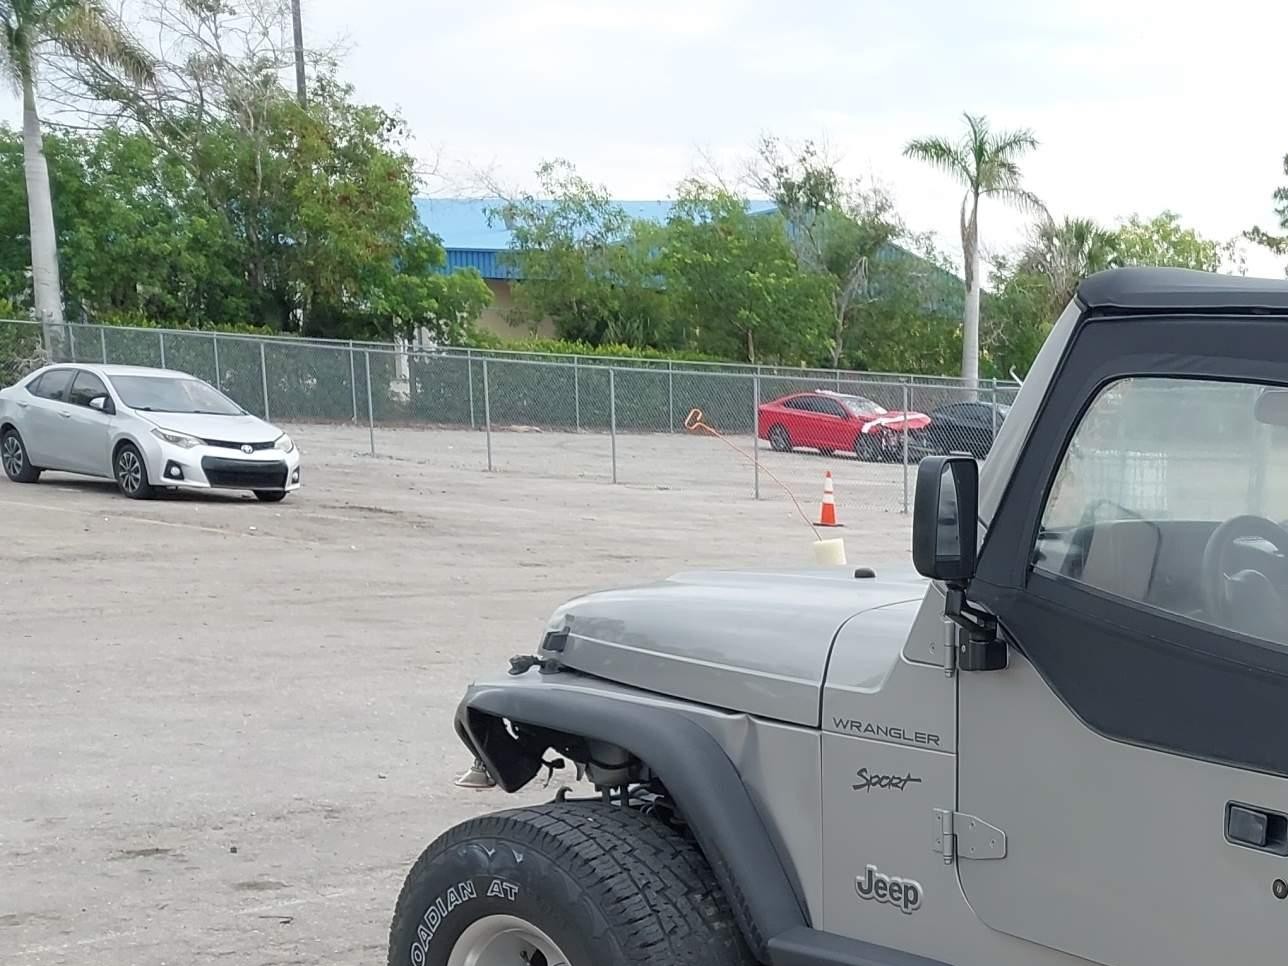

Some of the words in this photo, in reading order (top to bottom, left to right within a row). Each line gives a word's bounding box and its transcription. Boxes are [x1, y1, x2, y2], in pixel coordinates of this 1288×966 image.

[832, 717, 941, 746] WRANGLER
[852, 768, 922, 792] Sport
[487, 879, 520, 901] AT
[856, 865, 922, 914] Jeep
